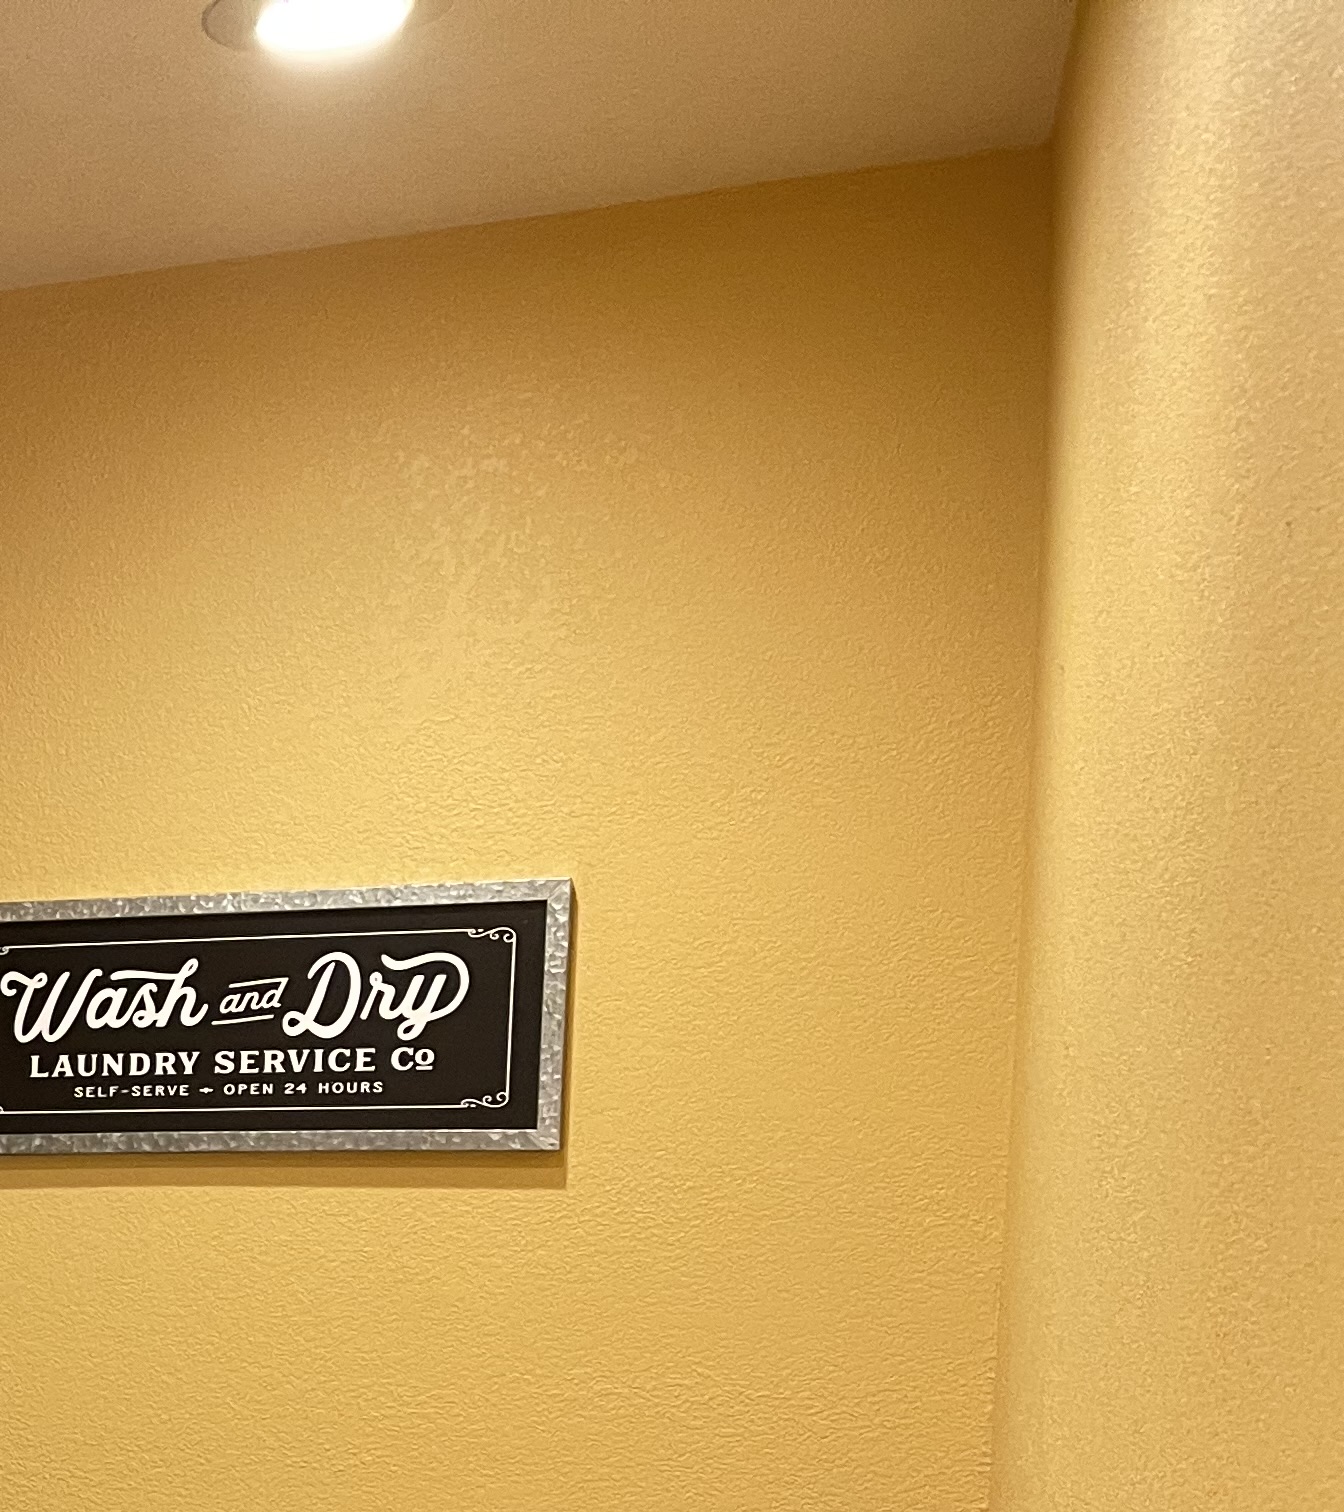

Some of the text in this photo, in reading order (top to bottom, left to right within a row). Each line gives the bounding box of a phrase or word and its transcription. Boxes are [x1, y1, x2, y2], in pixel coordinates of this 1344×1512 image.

[0, 951, 470, 1044] Wash and Dry
[29, 1051, 201, 1078] LAUNDRY
[213, 1047, 376, 1075] SERVICE
[73, 1081, 384, 1098] SELF-SERVE OPEN 24 HOURS
